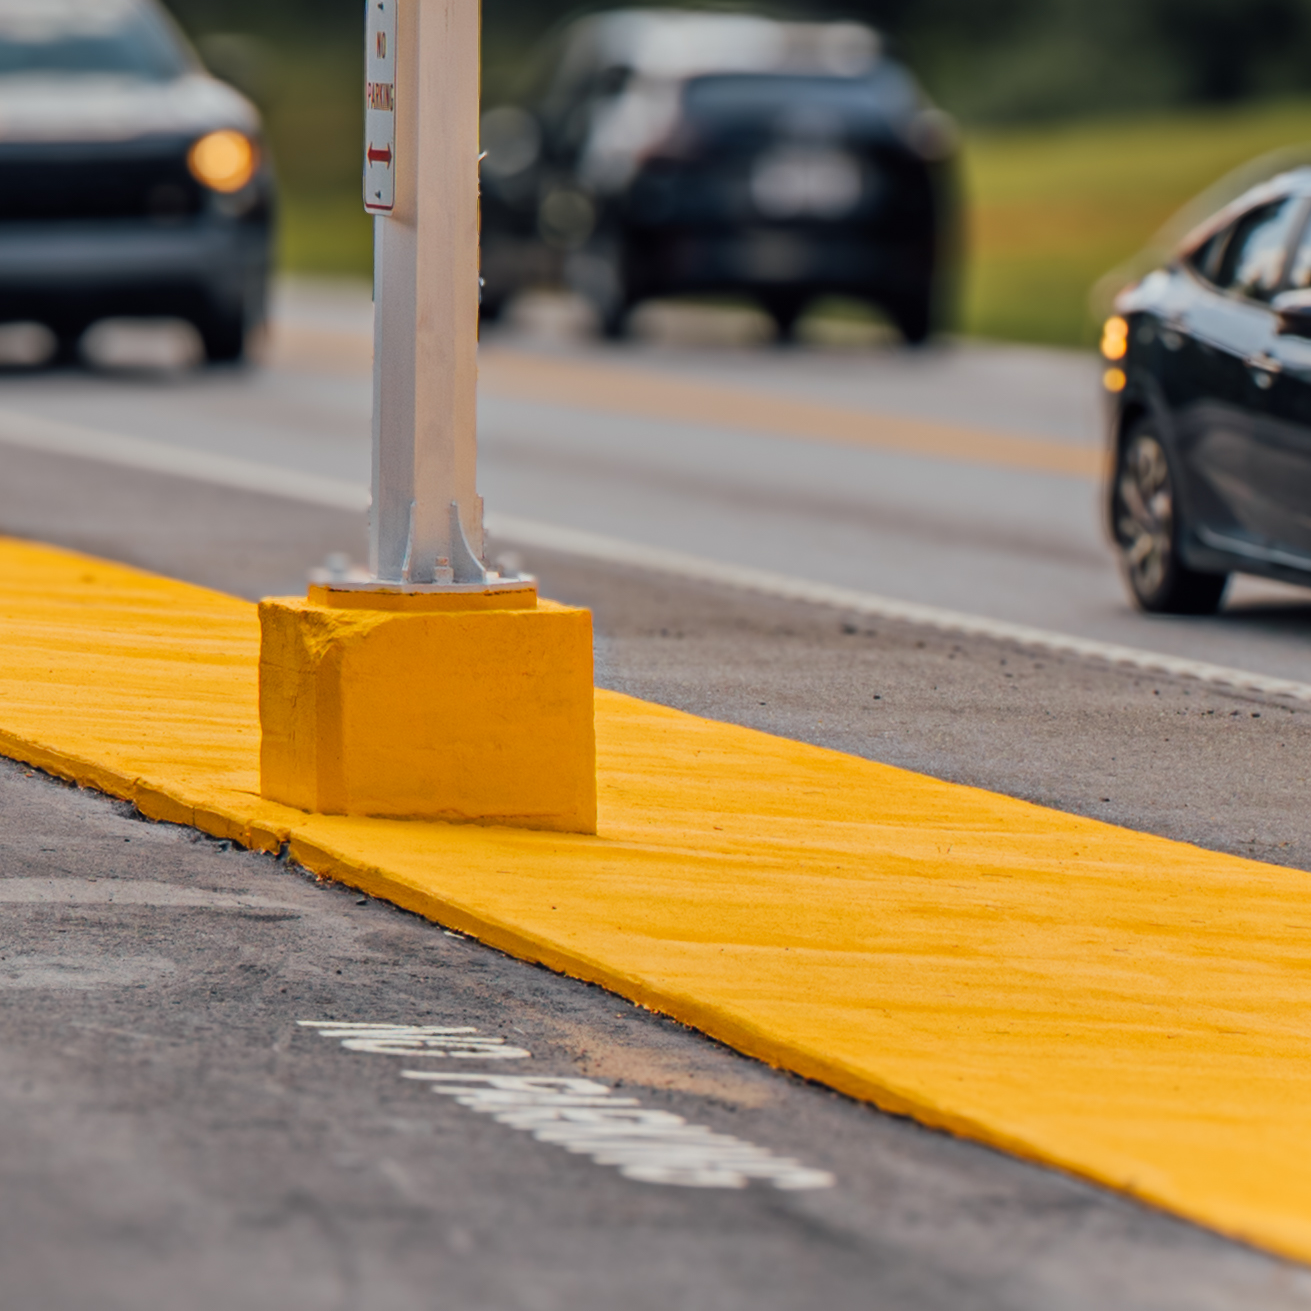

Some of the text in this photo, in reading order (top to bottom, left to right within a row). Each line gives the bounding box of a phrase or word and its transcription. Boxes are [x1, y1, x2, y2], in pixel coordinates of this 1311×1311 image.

[376, 31, 387, 60] NO
[367, 81, 395, 112] PARKING
[296, 1019, 531, 1059] NO
